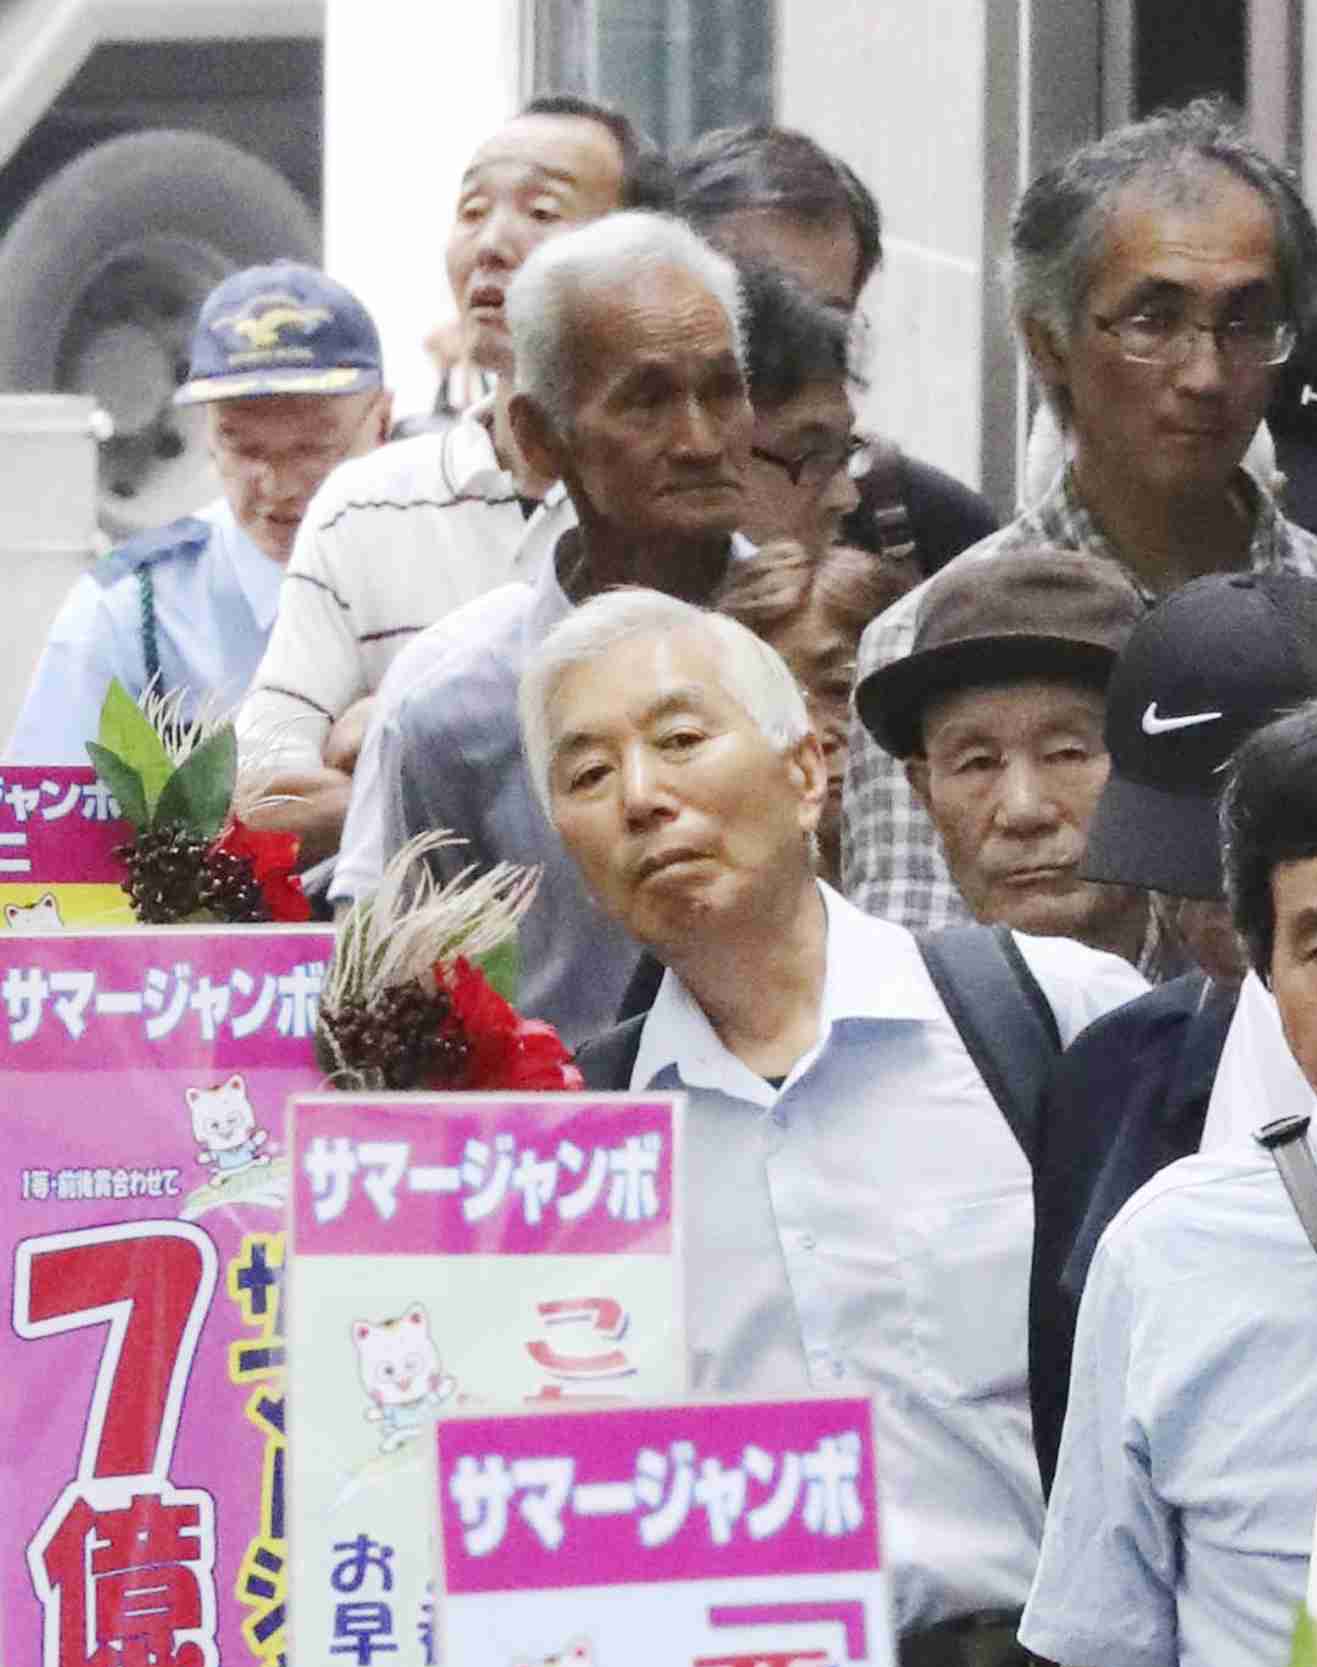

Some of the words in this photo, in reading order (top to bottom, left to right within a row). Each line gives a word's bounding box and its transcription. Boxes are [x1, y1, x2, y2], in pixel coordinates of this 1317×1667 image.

[304, 1133, 661, 1224] サマージャンボ
[450, 1430, 864, 1557] サマージャンボ
